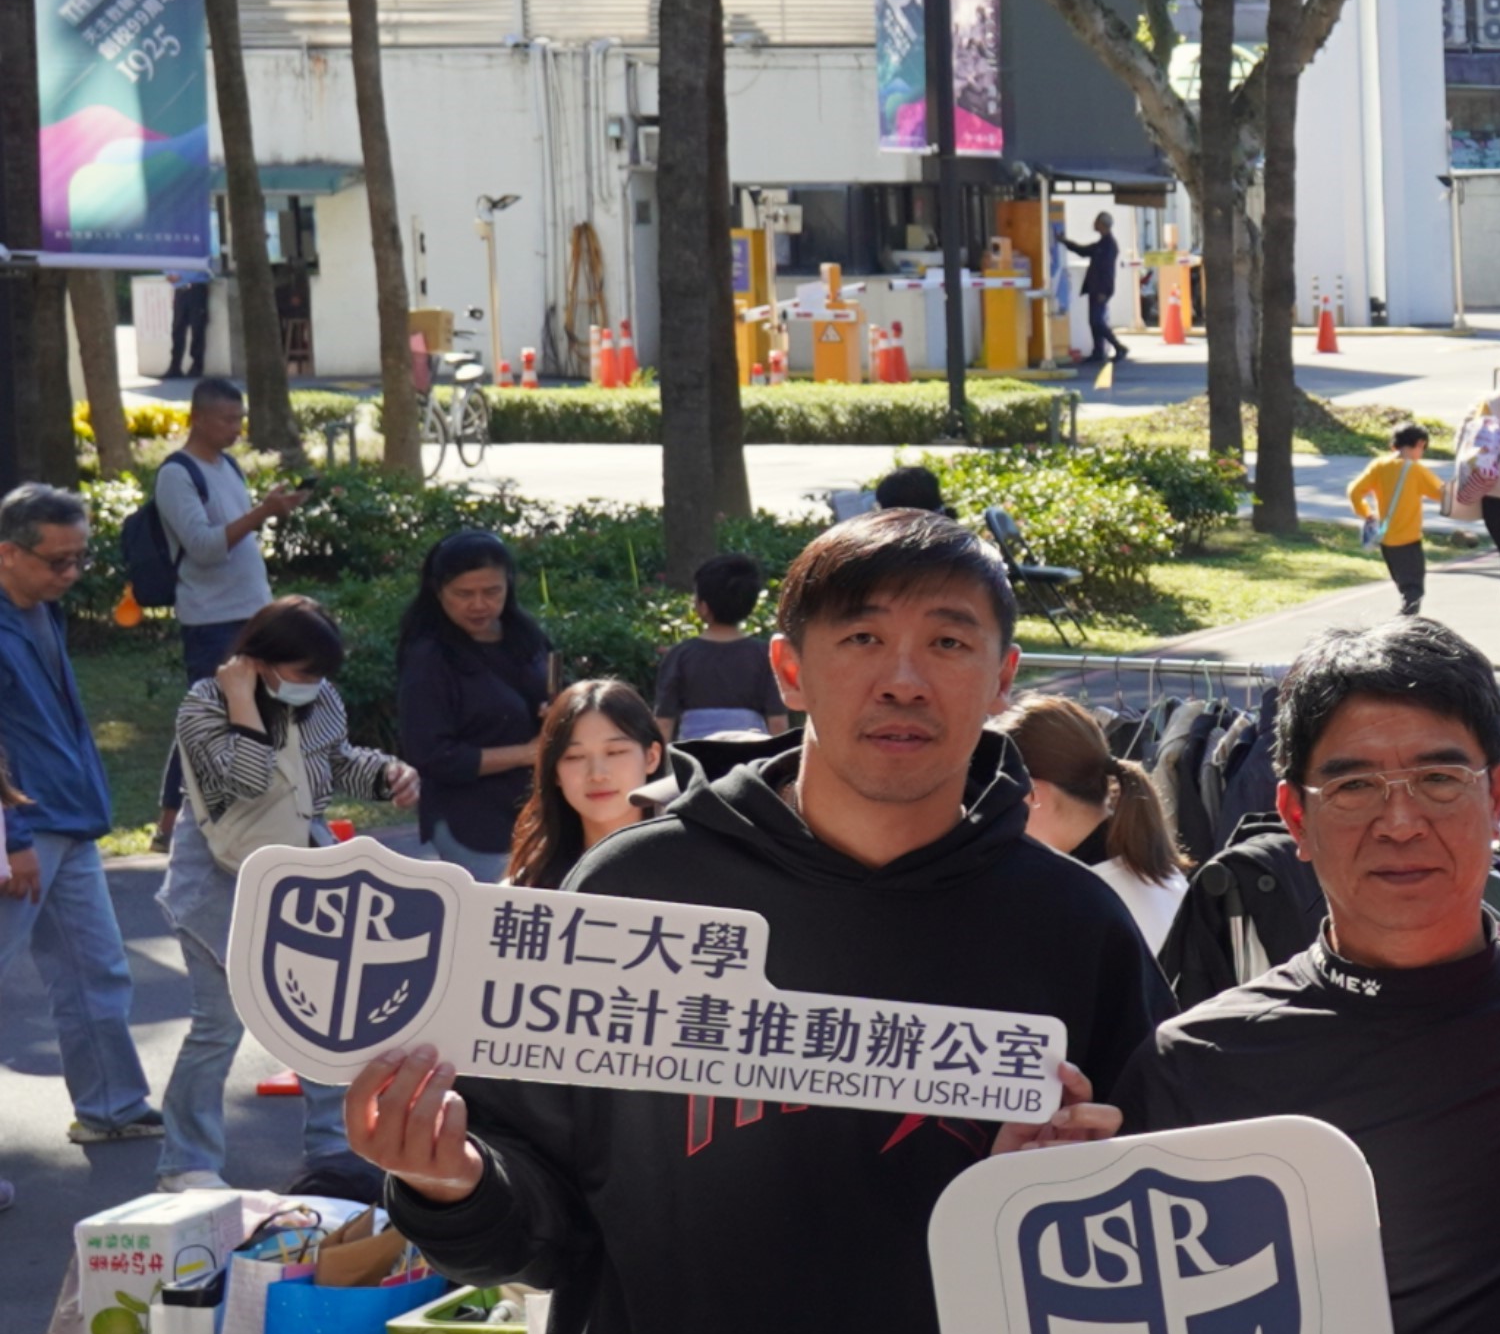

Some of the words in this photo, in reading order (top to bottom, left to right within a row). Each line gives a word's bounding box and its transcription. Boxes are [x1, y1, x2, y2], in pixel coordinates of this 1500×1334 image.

[116, 24, 182, 84] 1925
[489, 900, 752, 981] 輔仁大學
[480, 979, 1054, 1083] USR計畫推動辦公室
[472, 1037, 566, 1074] FUJEN
[574, 1045, 726, 1087] CATHOLIC
[733, 1058, 907, 1101] UNIVERSITY
[911, 1074, 1045, 1115] USR-HUB
